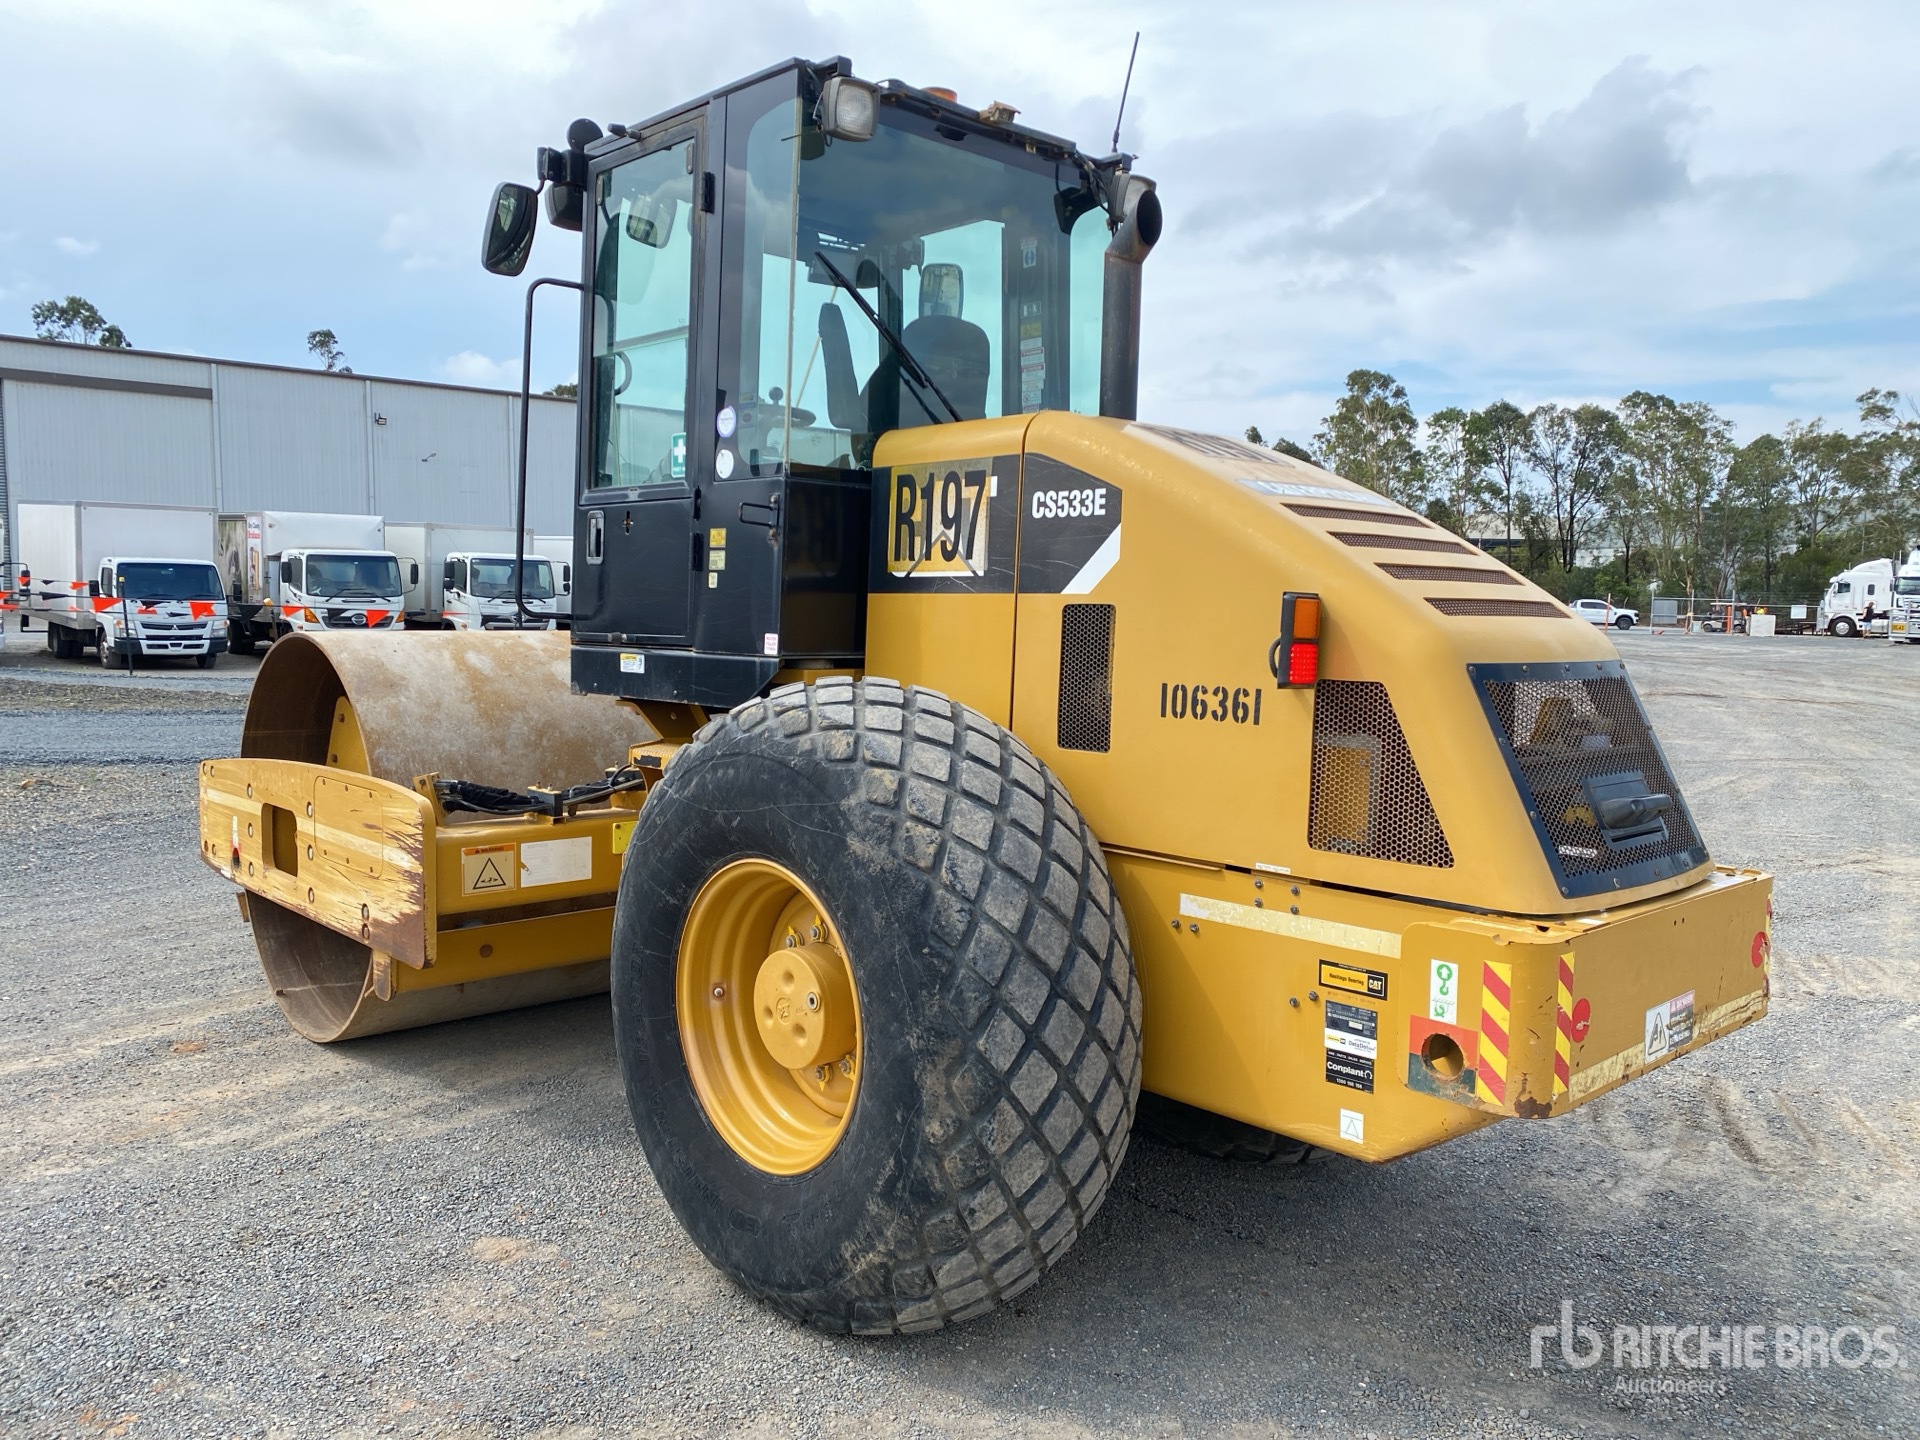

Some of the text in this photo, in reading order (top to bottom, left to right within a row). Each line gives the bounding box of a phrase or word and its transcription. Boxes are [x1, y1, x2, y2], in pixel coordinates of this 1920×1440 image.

[1031, 487, 1107, 519] CS533E
[894, 469, 987, 563] R197
[1160, 682, 1262, 726] 106361
[1329, 972, 1348, 982] Hastings
[1368, 979, 1383, 991] CAT
[1326, 1061, 1365, 1078] Conplant
